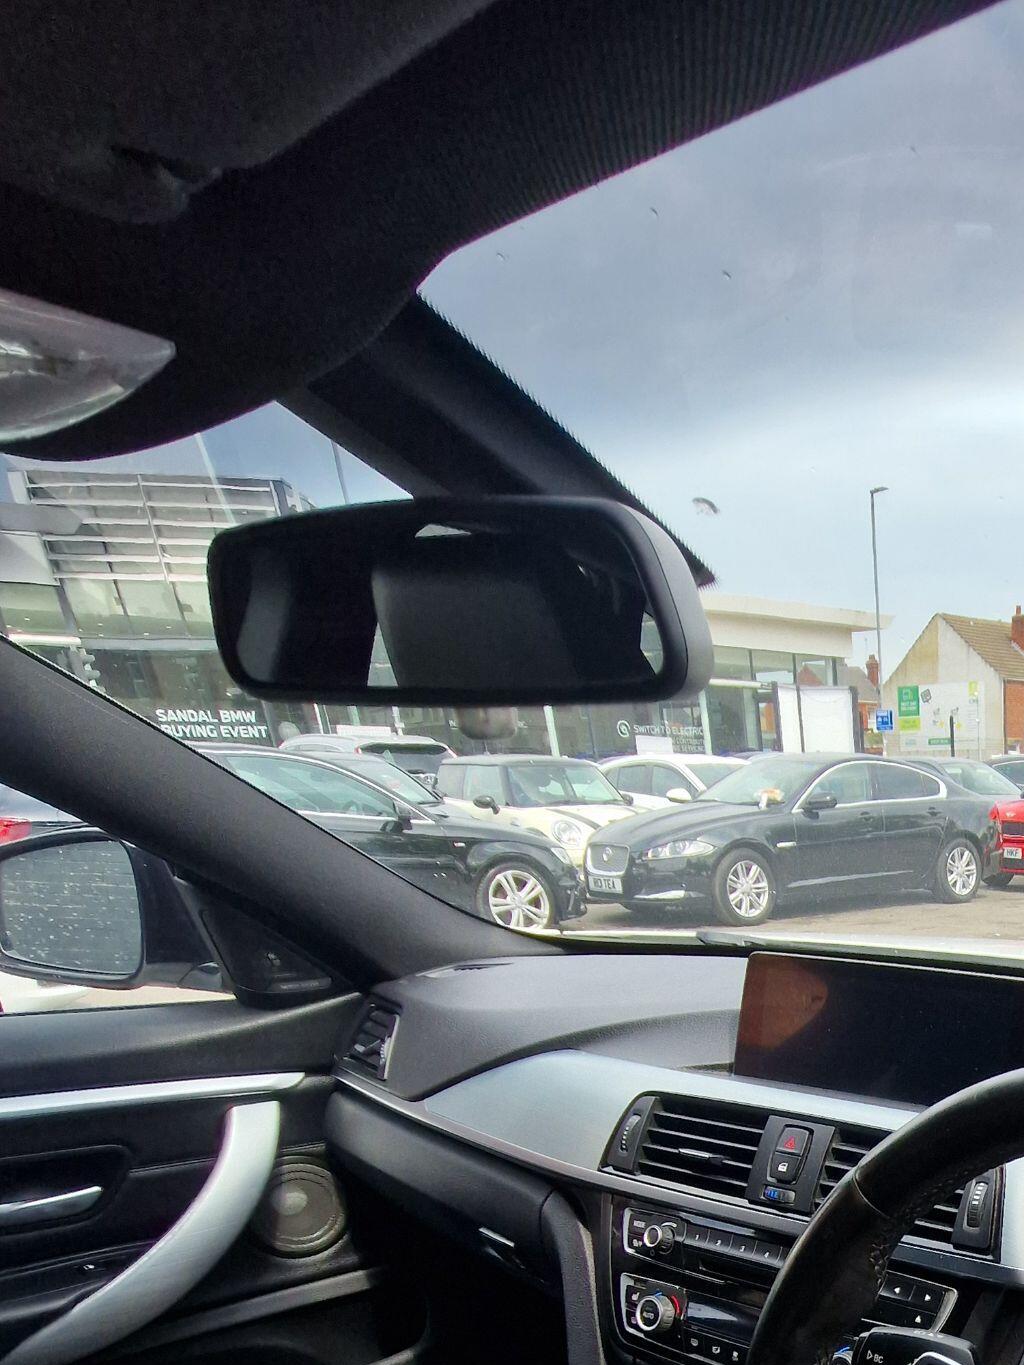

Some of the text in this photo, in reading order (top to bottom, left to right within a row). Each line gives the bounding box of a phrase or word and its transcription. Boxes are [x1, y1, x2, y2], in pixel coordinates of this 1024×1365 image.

[155, 709, 256, 723] SANDAL BMW
[220, 725, 267, 738] EVENT
[633, 724, 660, 735] SWITCH
[873, 1354, 884, 1364] BC
